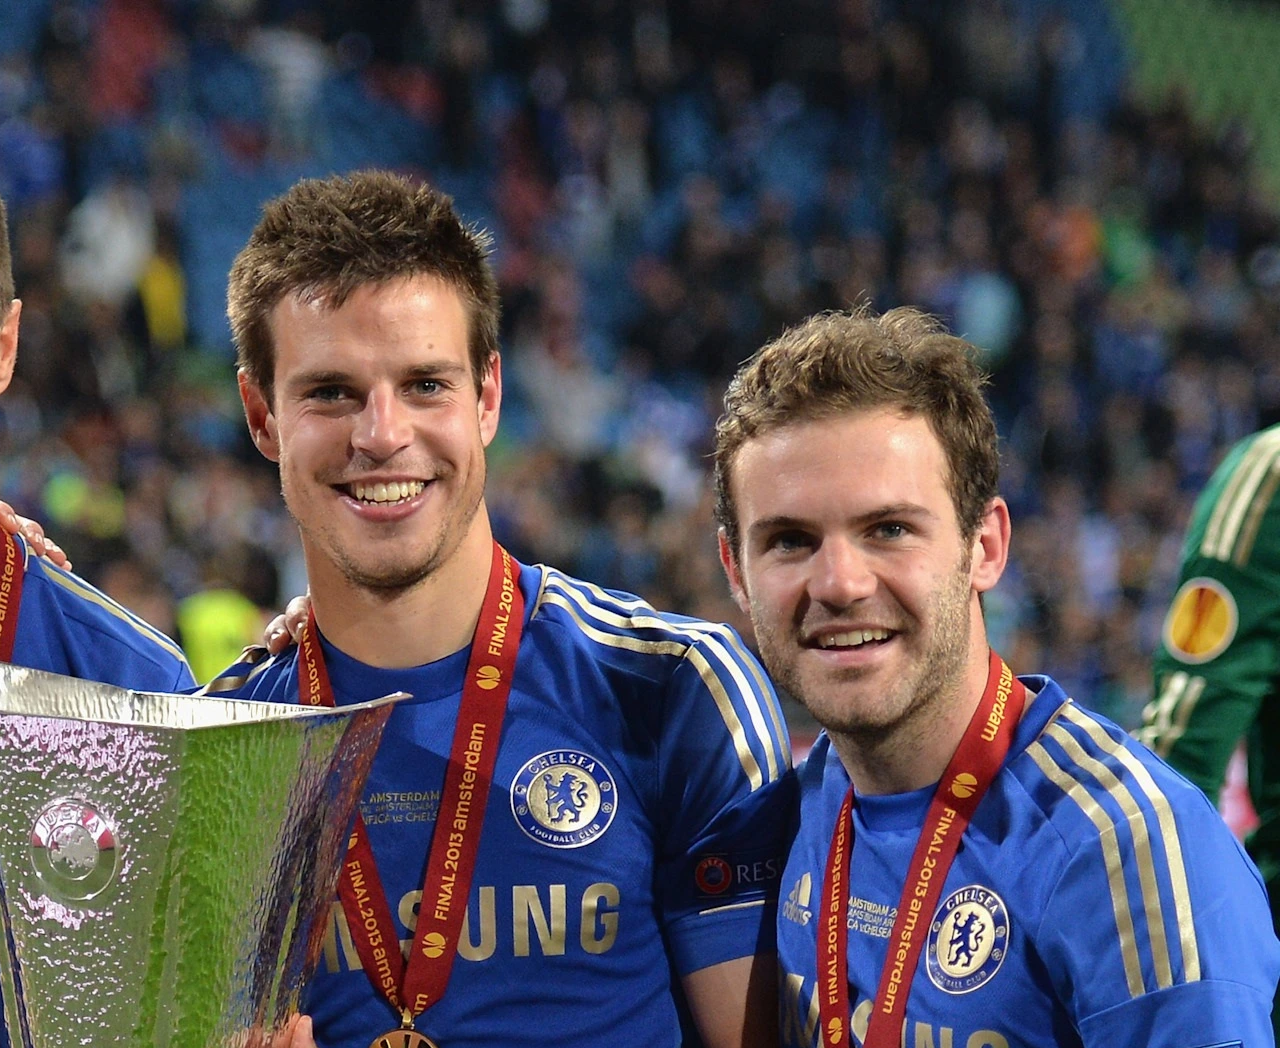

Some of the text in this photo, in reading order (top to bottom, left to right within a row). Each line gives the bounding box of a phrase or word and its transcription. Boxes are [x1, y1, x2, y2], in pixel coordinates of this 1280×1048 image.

[487, 614, 511, 657] FINAL
[502, 578, 516, 614] 2013
[306, 660, 321, 696] 2013
[454, 722, 487, 831] amsterdam
[528, 752, 595, 774] CHELSEA
[370, 790, 440, 804] AMSTERDAM
[406, 811, 438, 823] CHELS
[531, 823, 602, 843] FOOTBALL CLUB
[347, 860, 365, 910] FINAL
[359, 907, 383, 948] 2013
[435, 833, 464, 921] FINAL 2013
[827, 803, 849, 1006] FINAL 2013 amsterdam
[946, 892, 999, 914] CHELSEA
[323, 882, 621, 974] MSUNG
[882, 807, 956, 1015] FINAL 2013 amsterdam
[965, 970, 987, 987] CLUB
